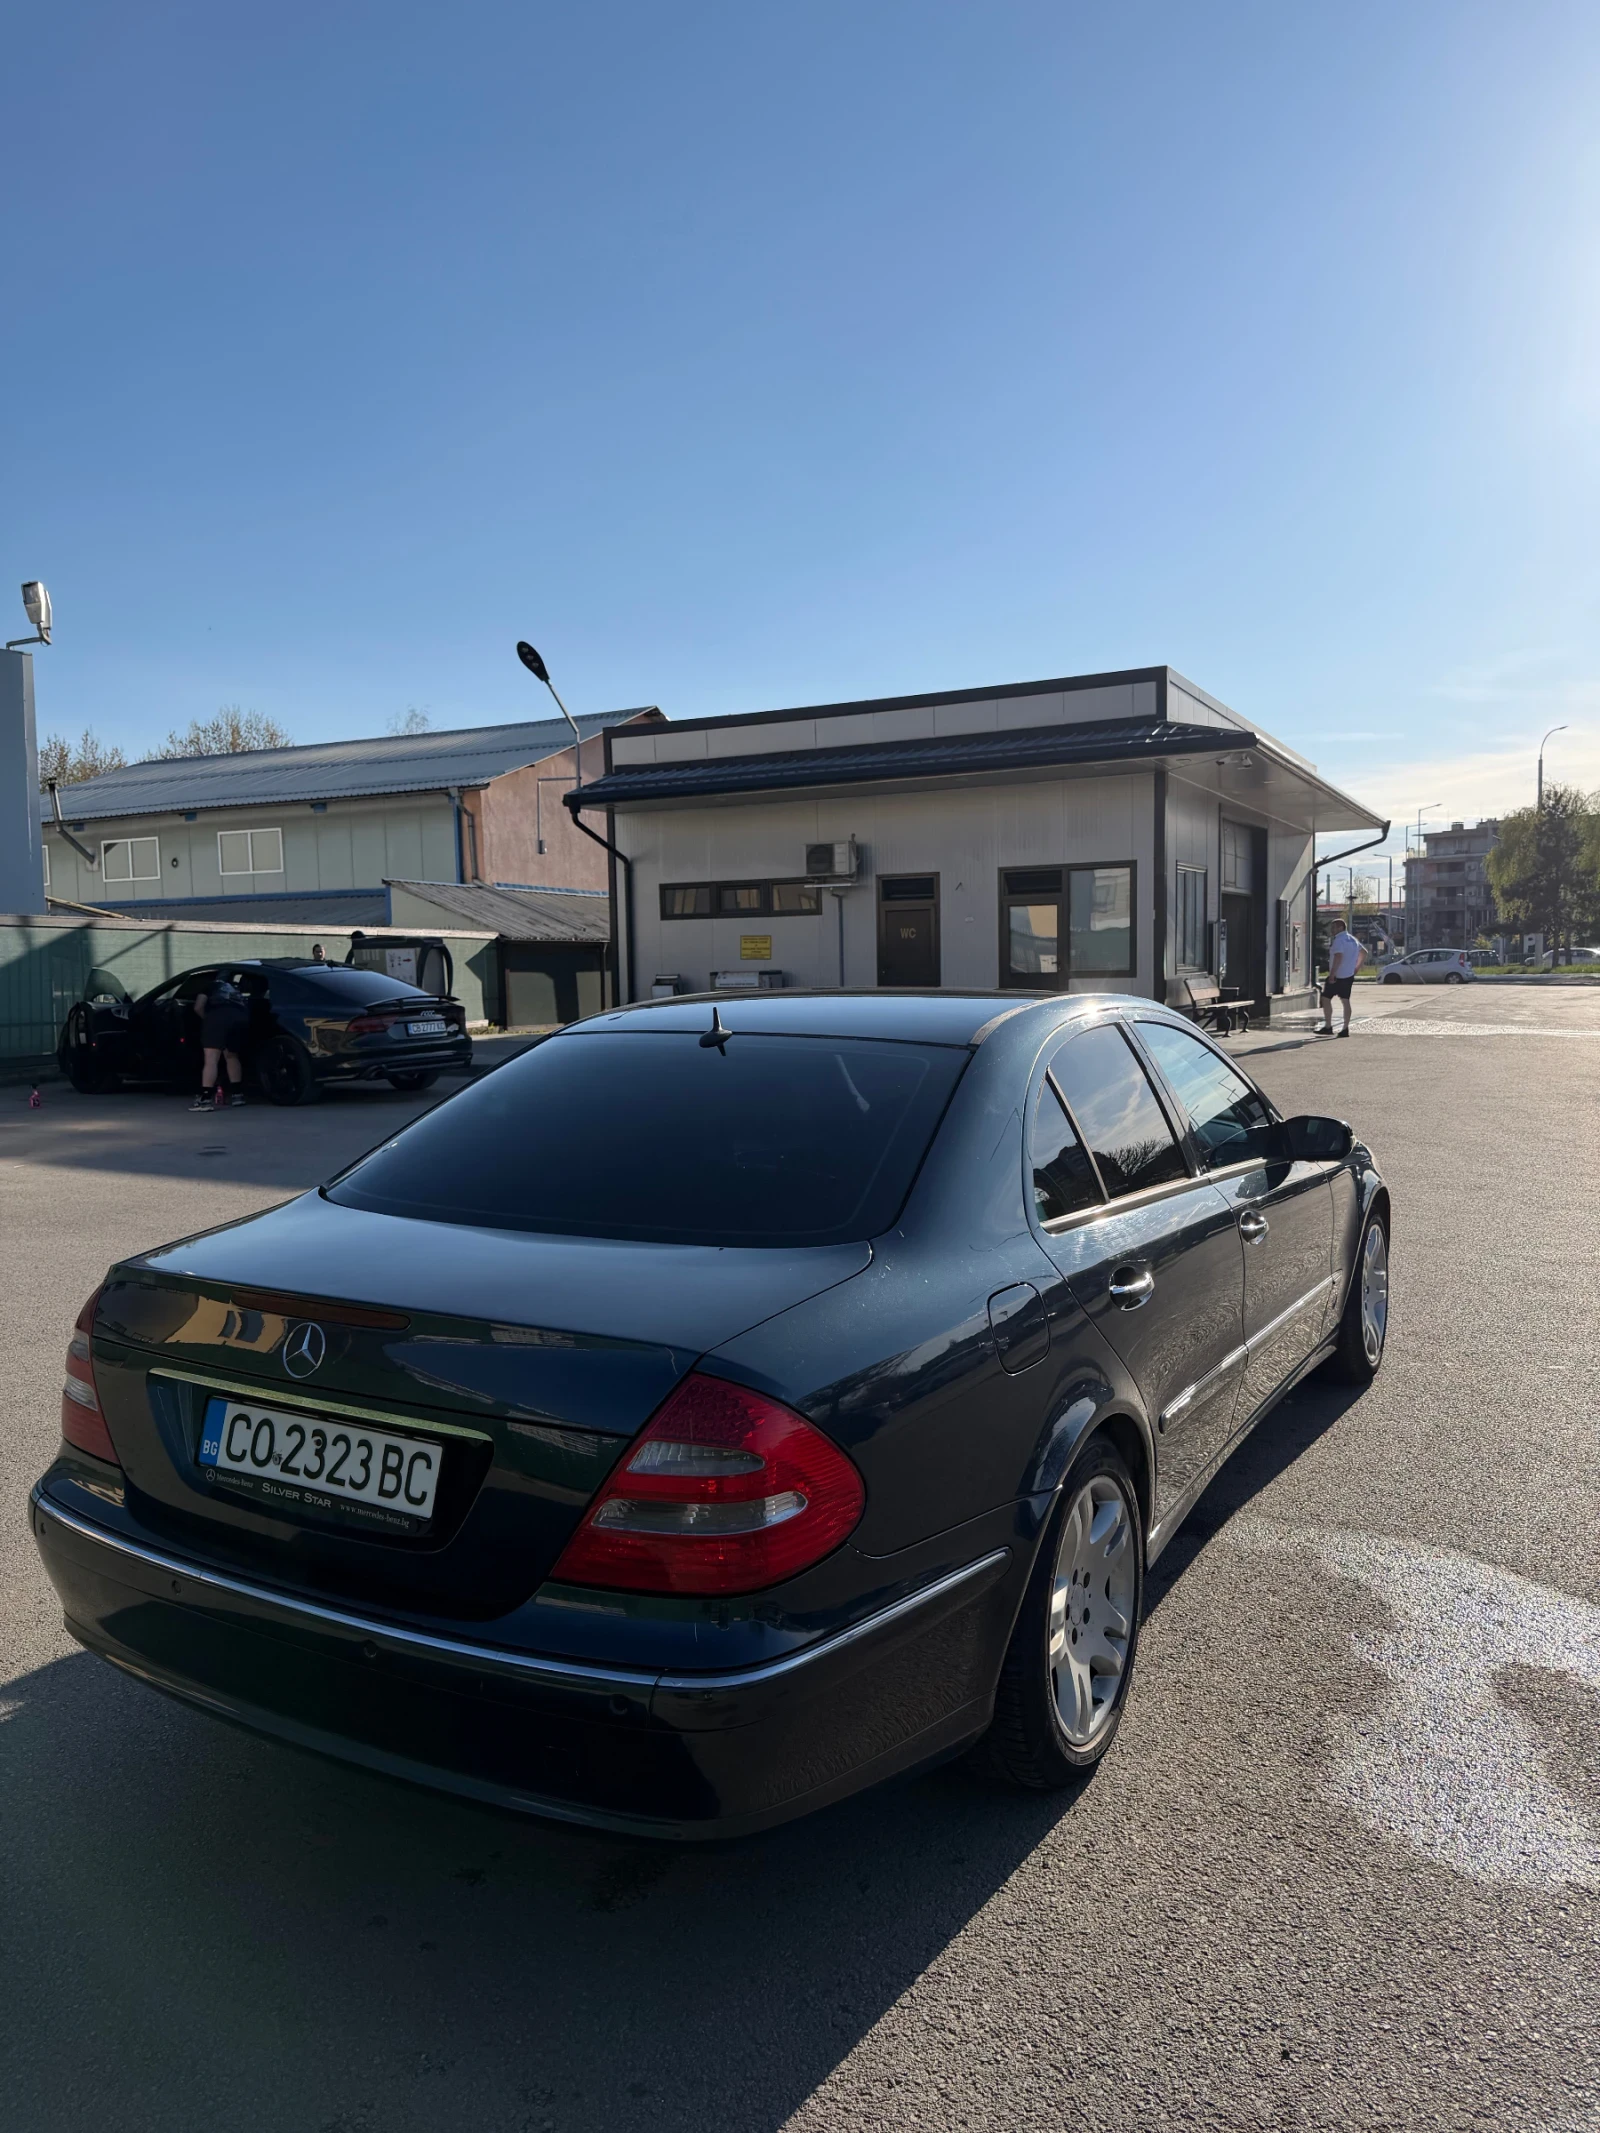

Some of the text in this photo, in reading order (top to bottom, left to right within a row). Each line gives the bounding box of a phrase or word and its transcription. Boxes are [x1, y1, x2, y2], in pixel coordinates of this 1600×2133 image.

[900, 927, 916, 939] WC
[202, 1439, 219, 1456] BG
[280, 1423, 373, 1491] 2323
[377, 1444, 432, 1506] BC
[340, 1504, 410, 1529] www.mercedes-benz.bg
